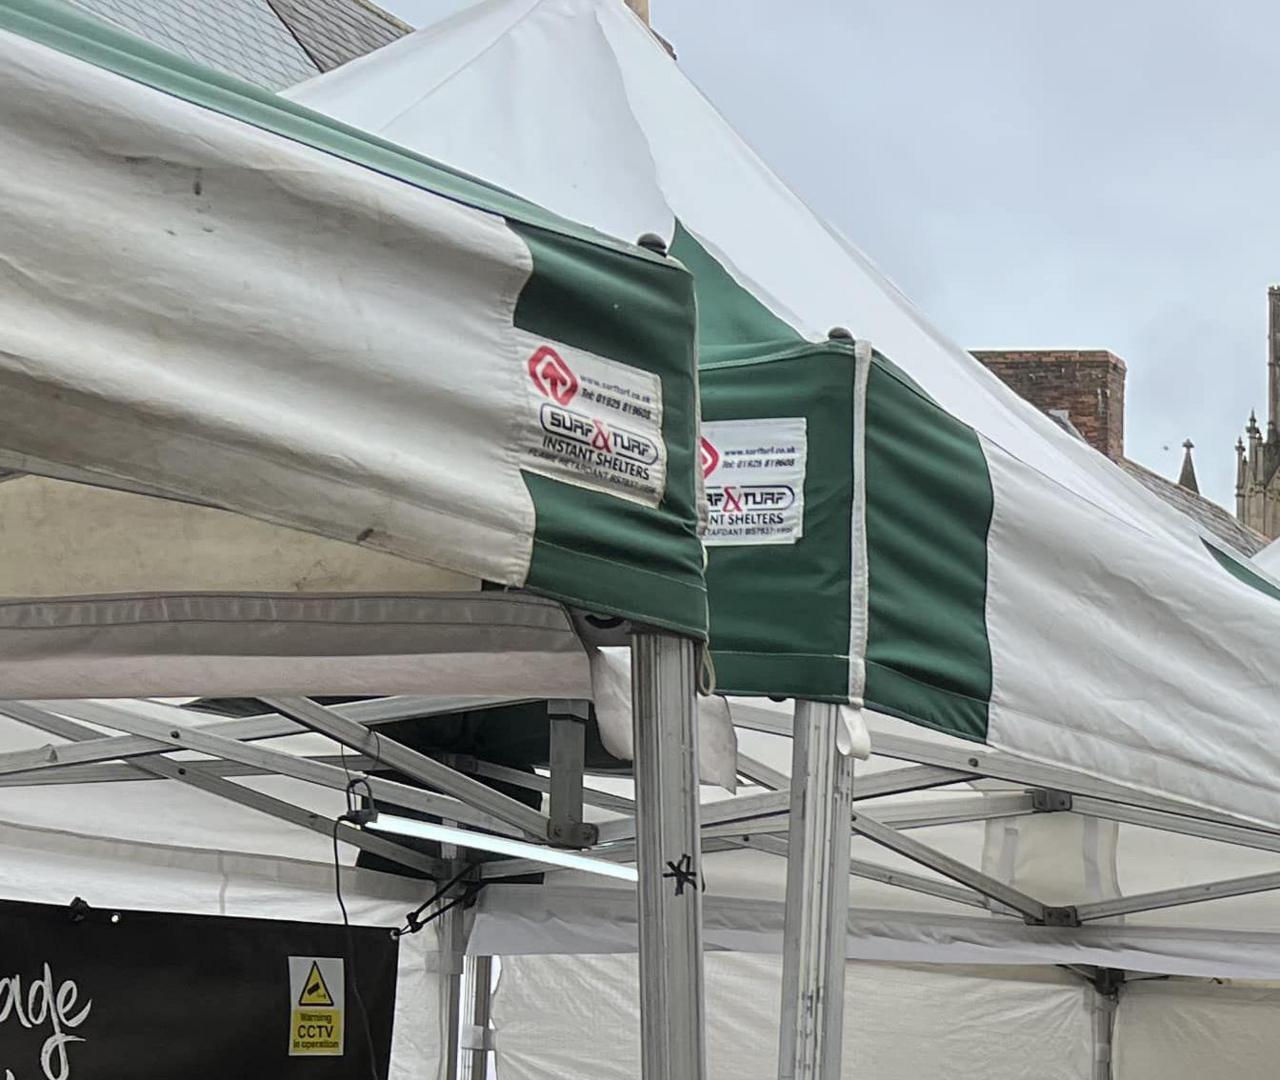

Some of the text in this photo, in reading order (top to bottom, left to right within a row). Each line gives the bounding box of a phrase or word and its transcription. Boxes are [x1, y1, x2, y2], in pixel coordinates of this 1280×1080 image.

[550, 411, 593, 437] SURF
[612, 432, 651, 456] TURF
[542, 436, 650, 480] INSTANT SHELTERS
[706, 492, 724, 506] RF
[744, 492, 786, 505] TURF
[728, 513, 784, 525] SHELTERS
[298, 1025, 334, 1039] CCTV
[301, 1040, 339, 1051] operation
